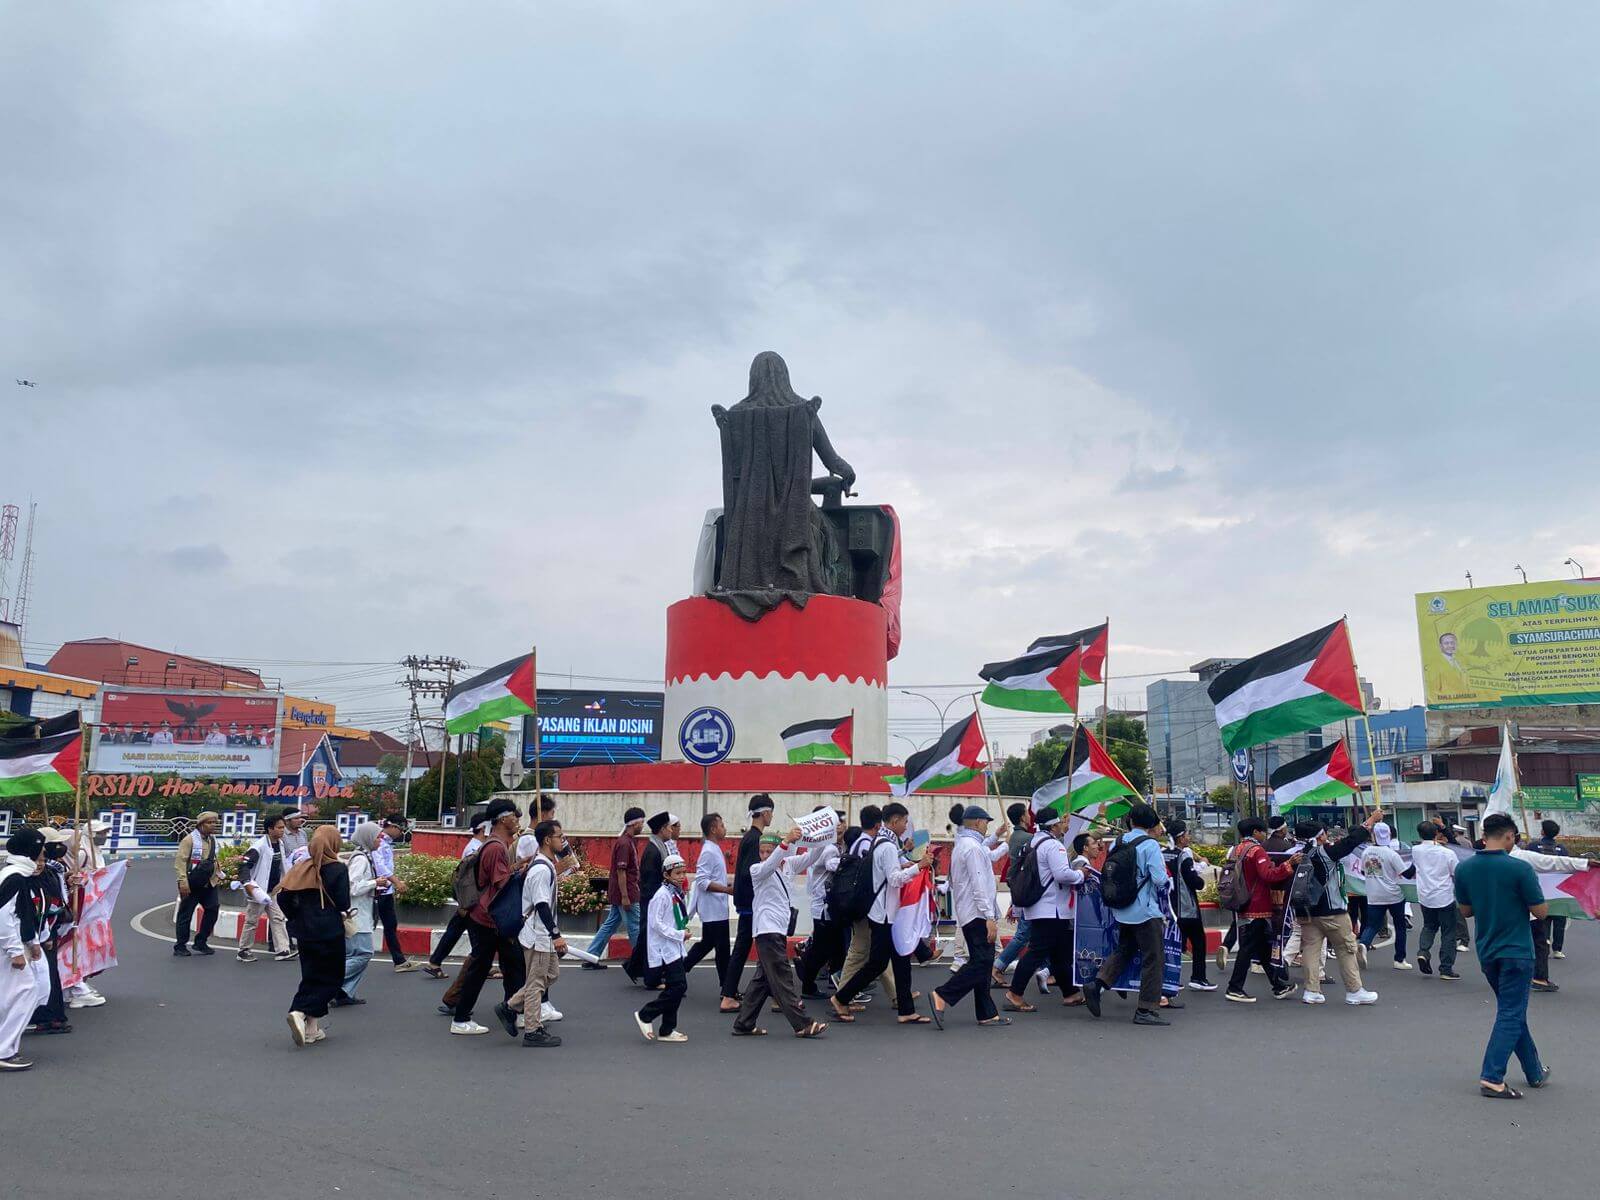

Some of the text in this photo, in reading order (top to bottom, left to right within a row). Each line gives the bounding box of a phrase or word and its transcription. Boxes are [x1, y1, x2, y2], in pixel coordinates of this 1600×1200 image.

[1488, 598, 1560, 618] SELAMAT
[1567, 594, 1600, 611] SUK
[1545, 616, 1598, 625] TERPILIHNYA
[291, 707, 328, 726] Bengkulu
[537, 717, 653, 734] PASANG IKLAN DISINI
[200, 754, 250, 762] PANCASILA
[87, 774, 154, 797] RSUD
[158, 777, 261, 798] Harpan
[266, 777, 310, 798] dan
